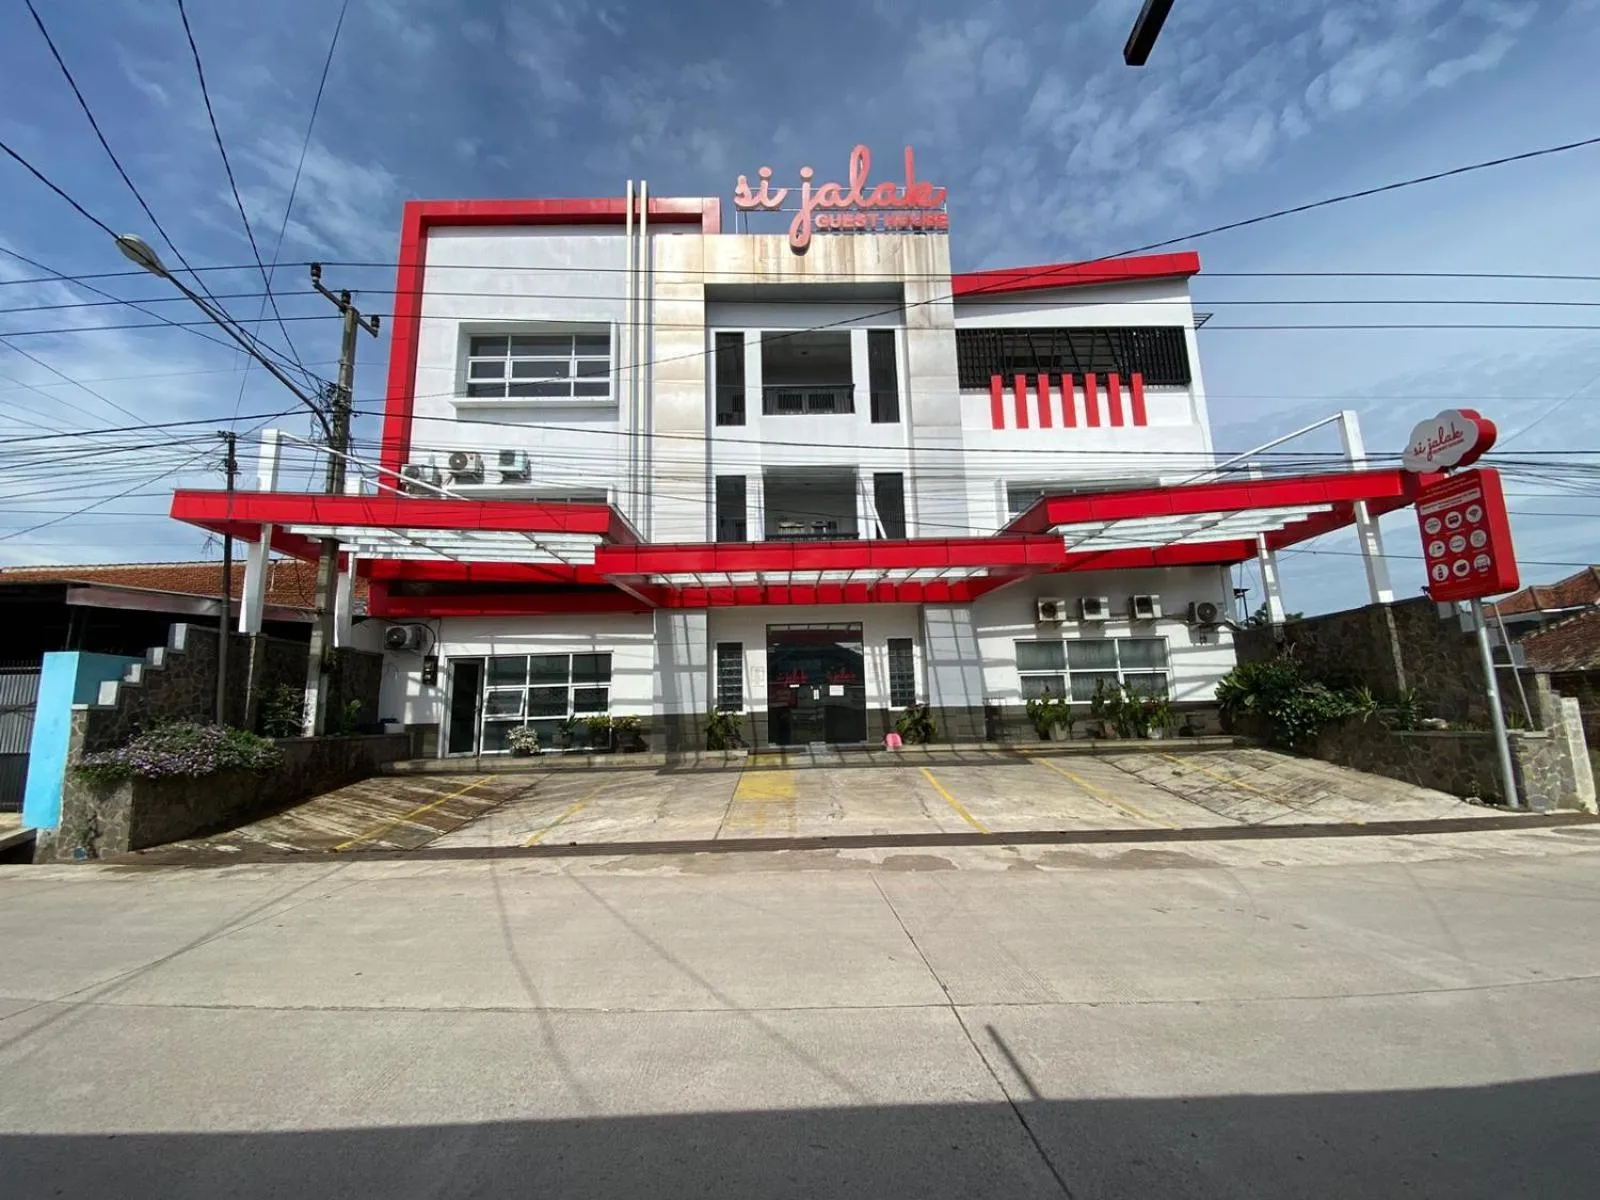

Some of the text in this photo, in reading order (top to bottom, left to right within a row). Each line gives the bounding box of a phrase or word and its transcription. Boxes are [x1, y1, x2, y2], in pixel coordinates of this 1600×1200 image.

[734, 144, 948, 256] si jalak
[815, 213, 881, 229] GUEST
[1427, 421, 1464, 462] jalak
